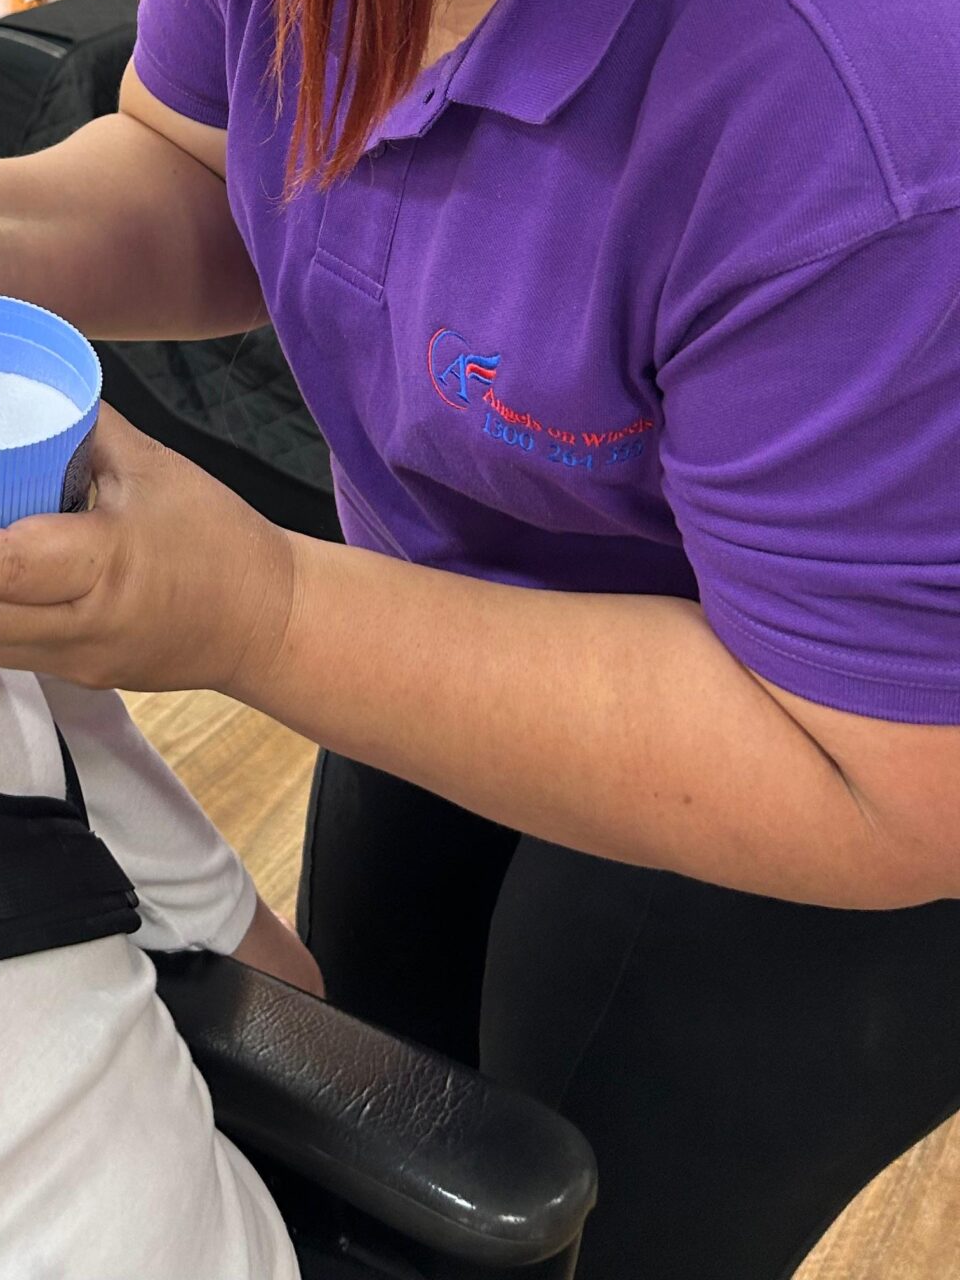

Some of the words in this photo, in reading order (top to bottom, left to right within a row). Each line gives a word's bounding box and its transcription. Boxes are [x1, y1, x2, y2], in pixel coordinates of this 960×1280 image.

[482, 388, 543, 433] Angels
[547, 426, 577, 446] on
[581, 416, 654, 448] Wheels
[482, 412, 535, 453] 1300
[548, 444, 595, 471] 264
